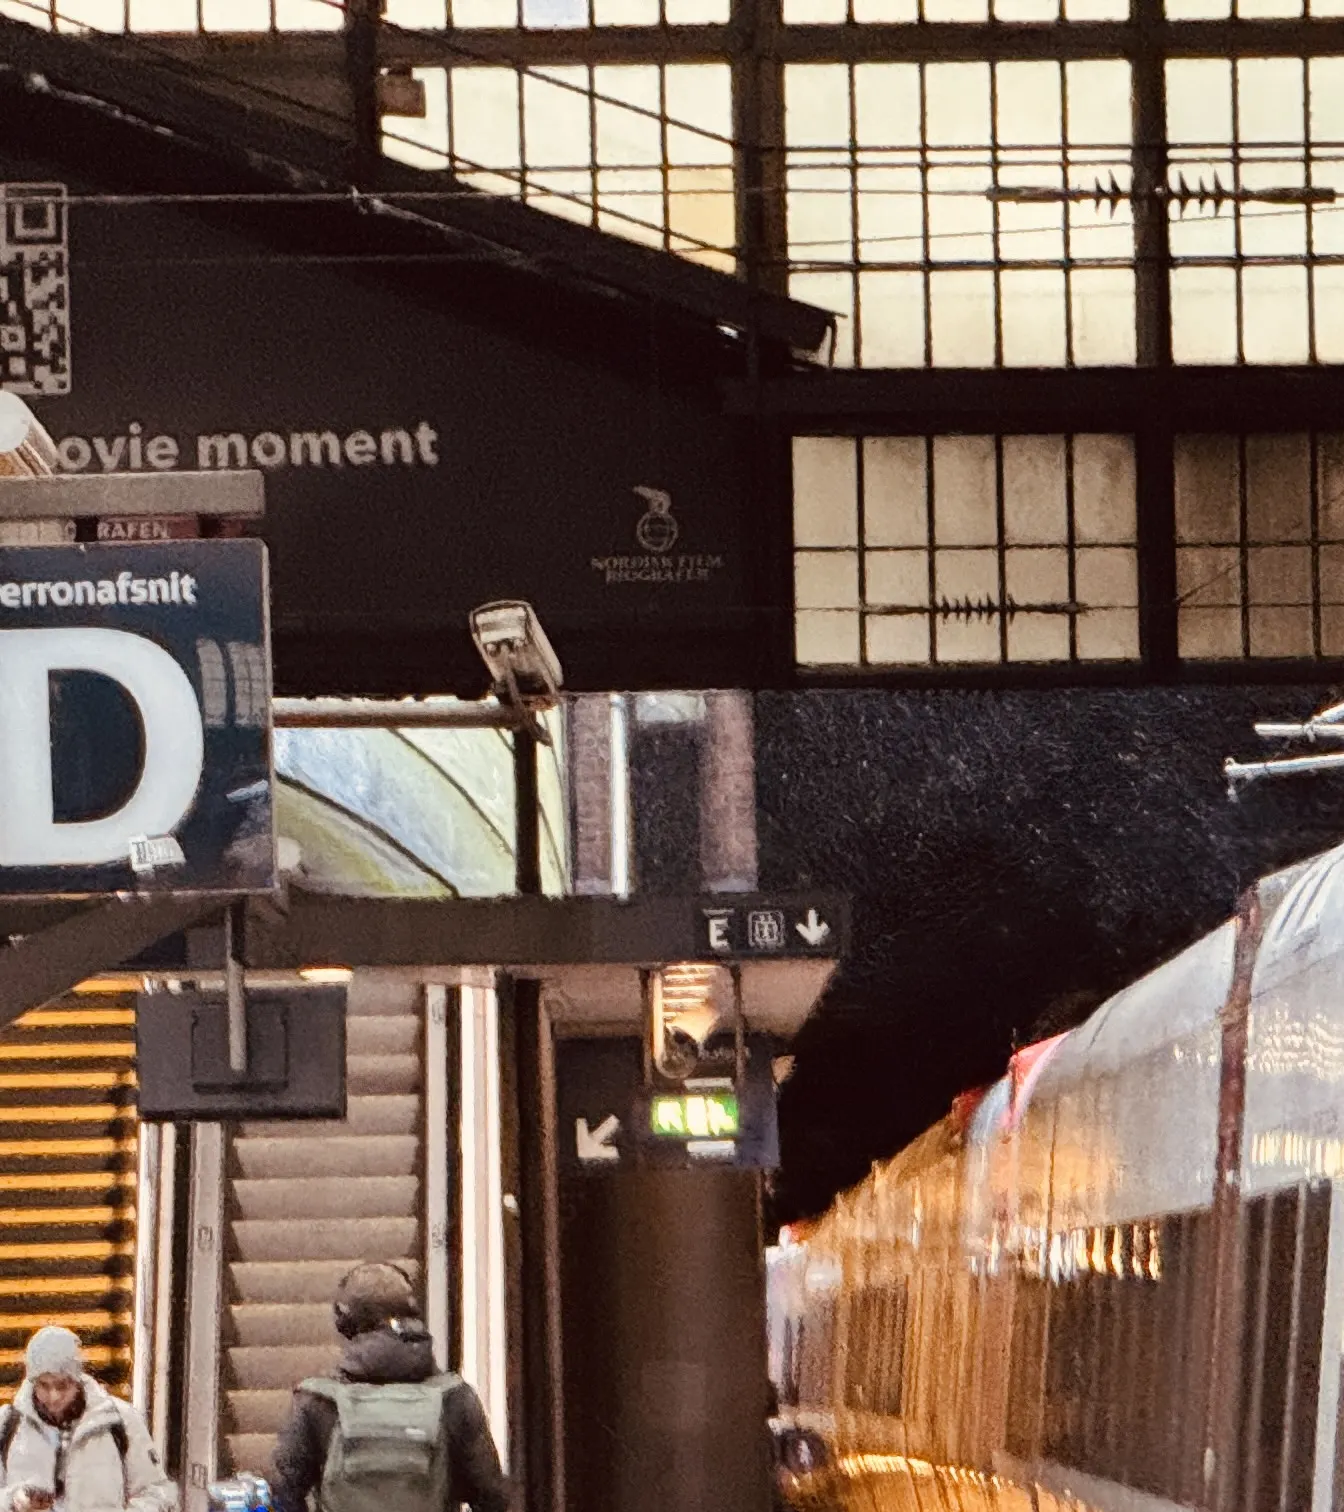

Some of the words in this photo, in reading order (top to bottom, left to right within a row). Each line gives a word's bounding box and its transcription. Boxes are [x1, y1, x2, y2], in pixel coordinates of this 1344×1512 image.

[57, 423, 180, 470] ovie
[198, 422, 438, 466] moment
[0, 571, 197, 608] erronafsnit
[0, 628, 204, 867] D
